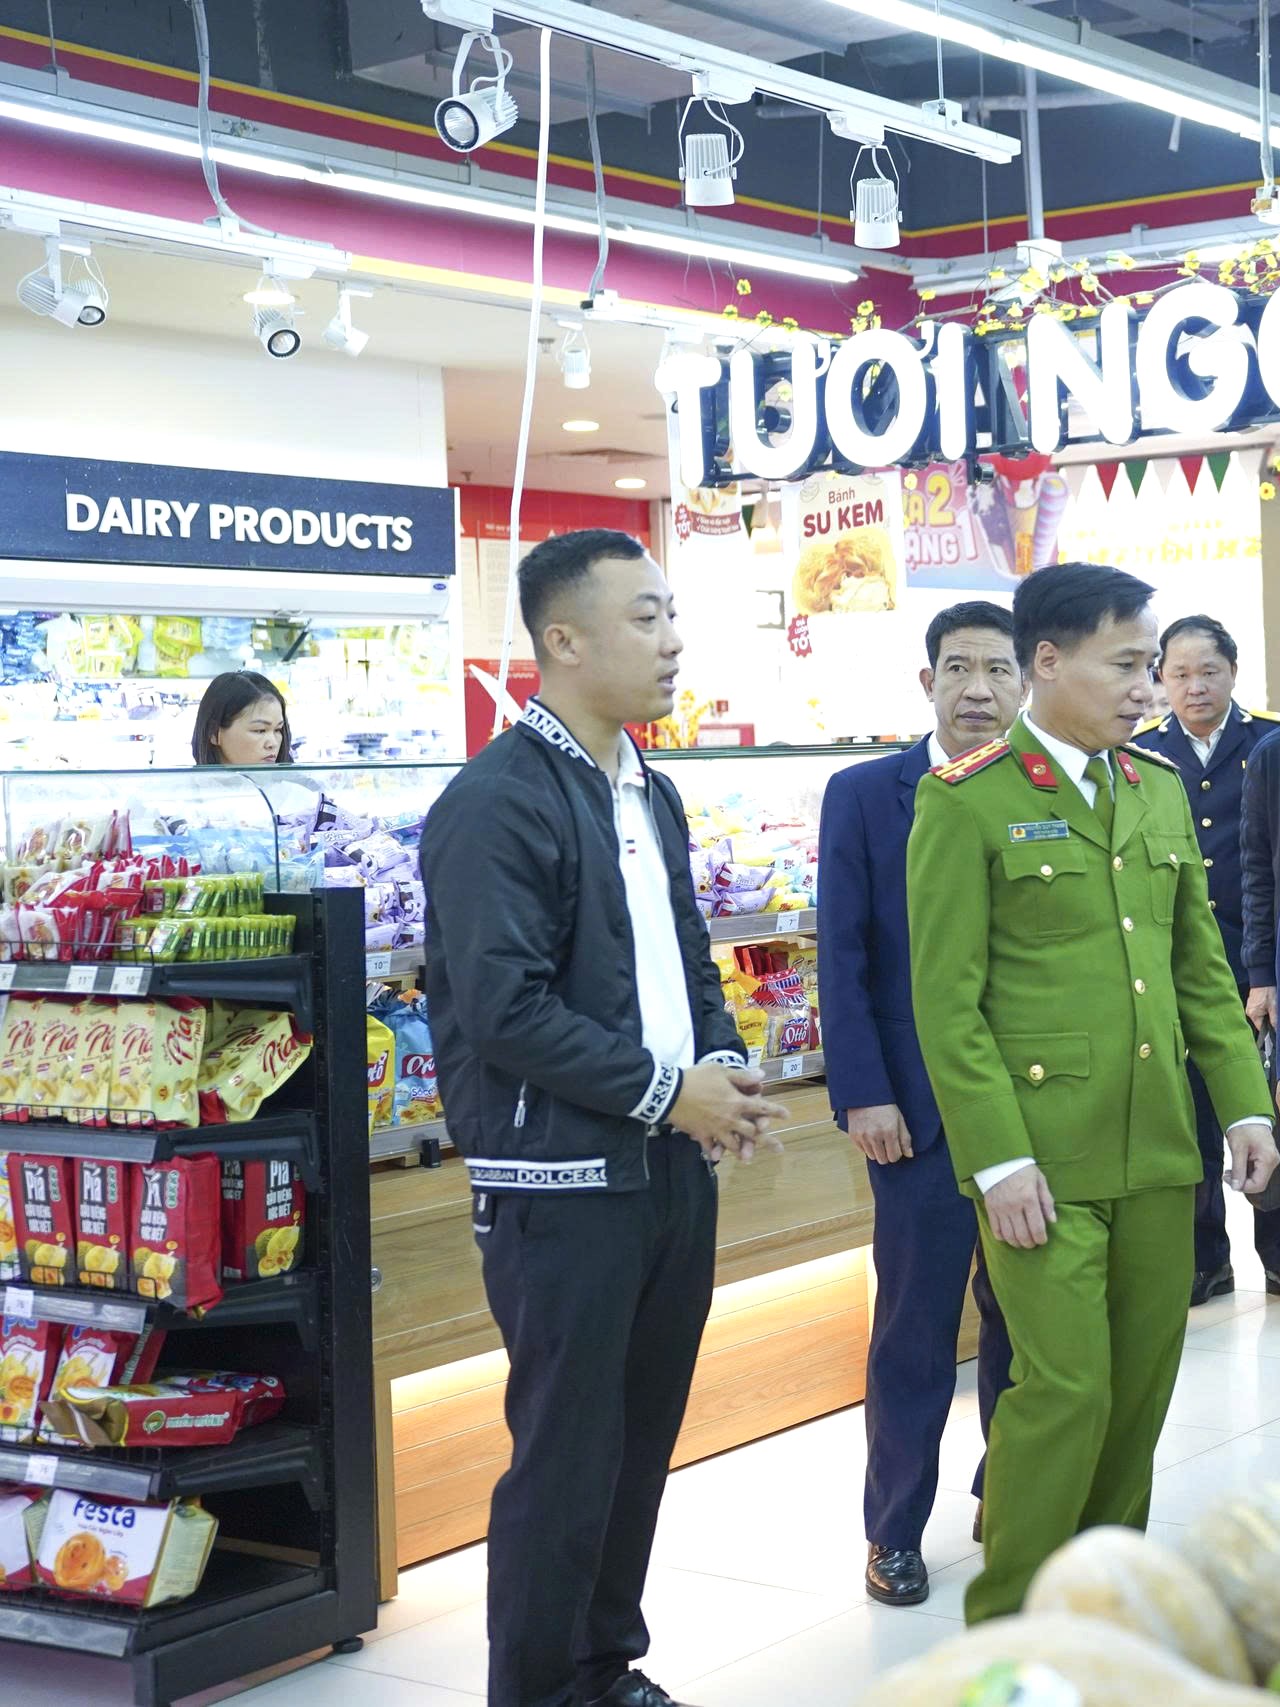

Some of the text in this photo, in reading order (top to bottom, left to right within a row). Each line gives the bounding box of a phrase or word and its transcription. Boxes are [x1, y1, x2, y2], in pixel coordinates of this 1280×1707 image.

[655, 321, 968, 488] TƯƠI
[828, 488, 856, 505] Bánh
[66, 493, 413, 551] DAIRY PRODUCTS
[803, 499, 884, 538] SU KEM
[73, 1498, 137, 1529] Festa
